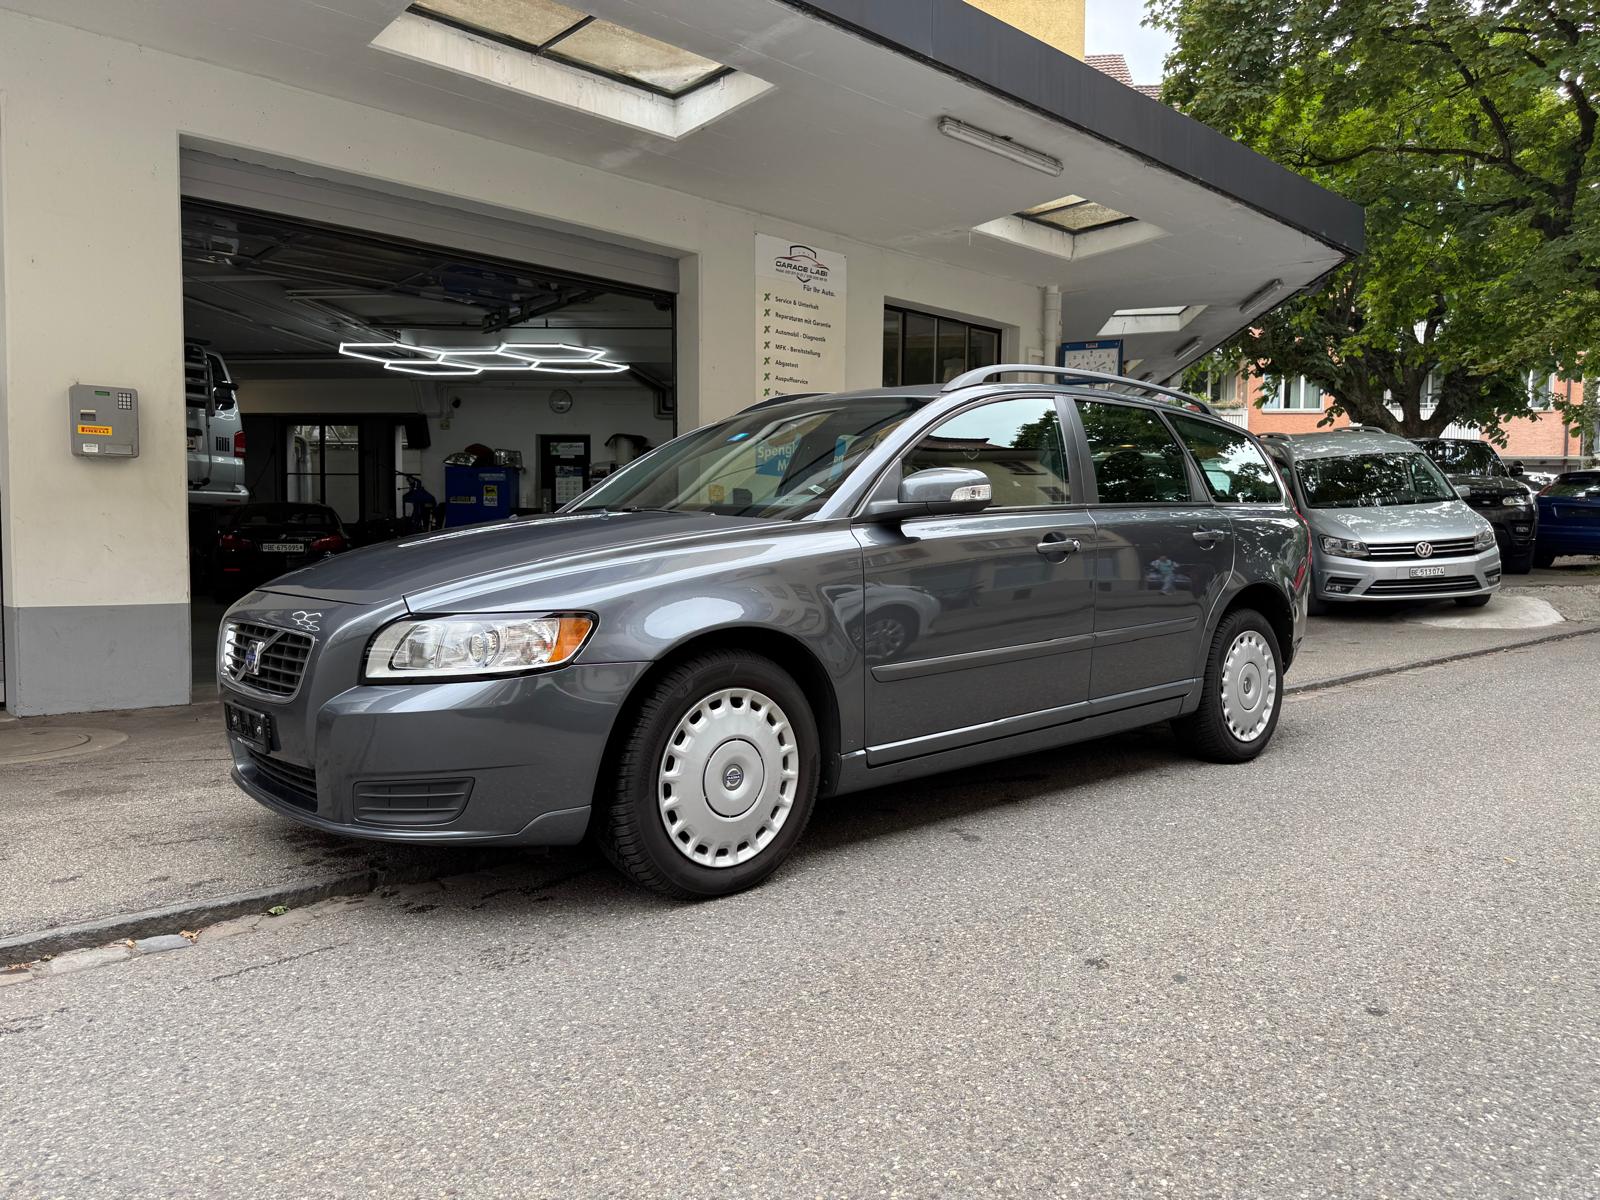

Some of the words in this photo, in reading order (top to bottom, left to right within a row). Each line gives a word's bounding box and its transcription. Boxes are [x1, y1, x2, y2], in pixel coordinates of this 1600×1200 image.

[776, 261, 808, 272] GARAGE
[775, 296, 792, 304] Service
[775, 312, 804, 322] Reparaturen
[812, 320, 831, 328] Garantie
[775, 328, 800, 338] Automobil
